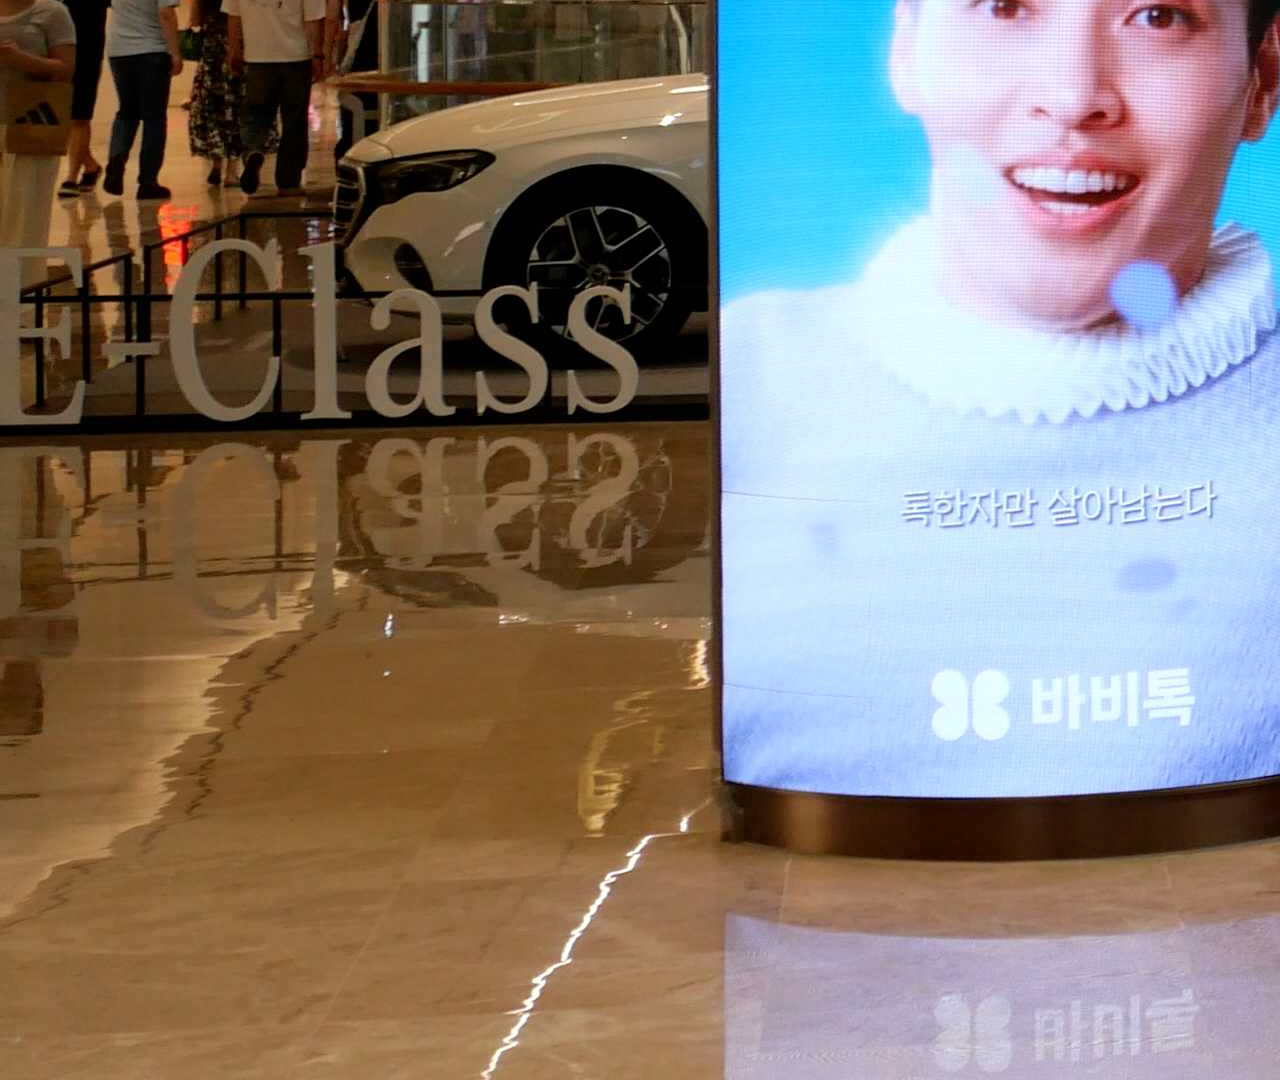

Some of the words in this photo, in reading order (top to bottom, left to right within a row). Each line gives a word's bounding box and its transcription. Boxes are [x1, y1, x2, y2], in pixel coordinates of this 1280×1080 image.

[0, 238, 640, 426] E-Class
[901, 488, 1038, 528] 톡한자만
[1048, 480, 1217, 527] 살아남는다
[1031, 668, 1195, 730] 바비톡
